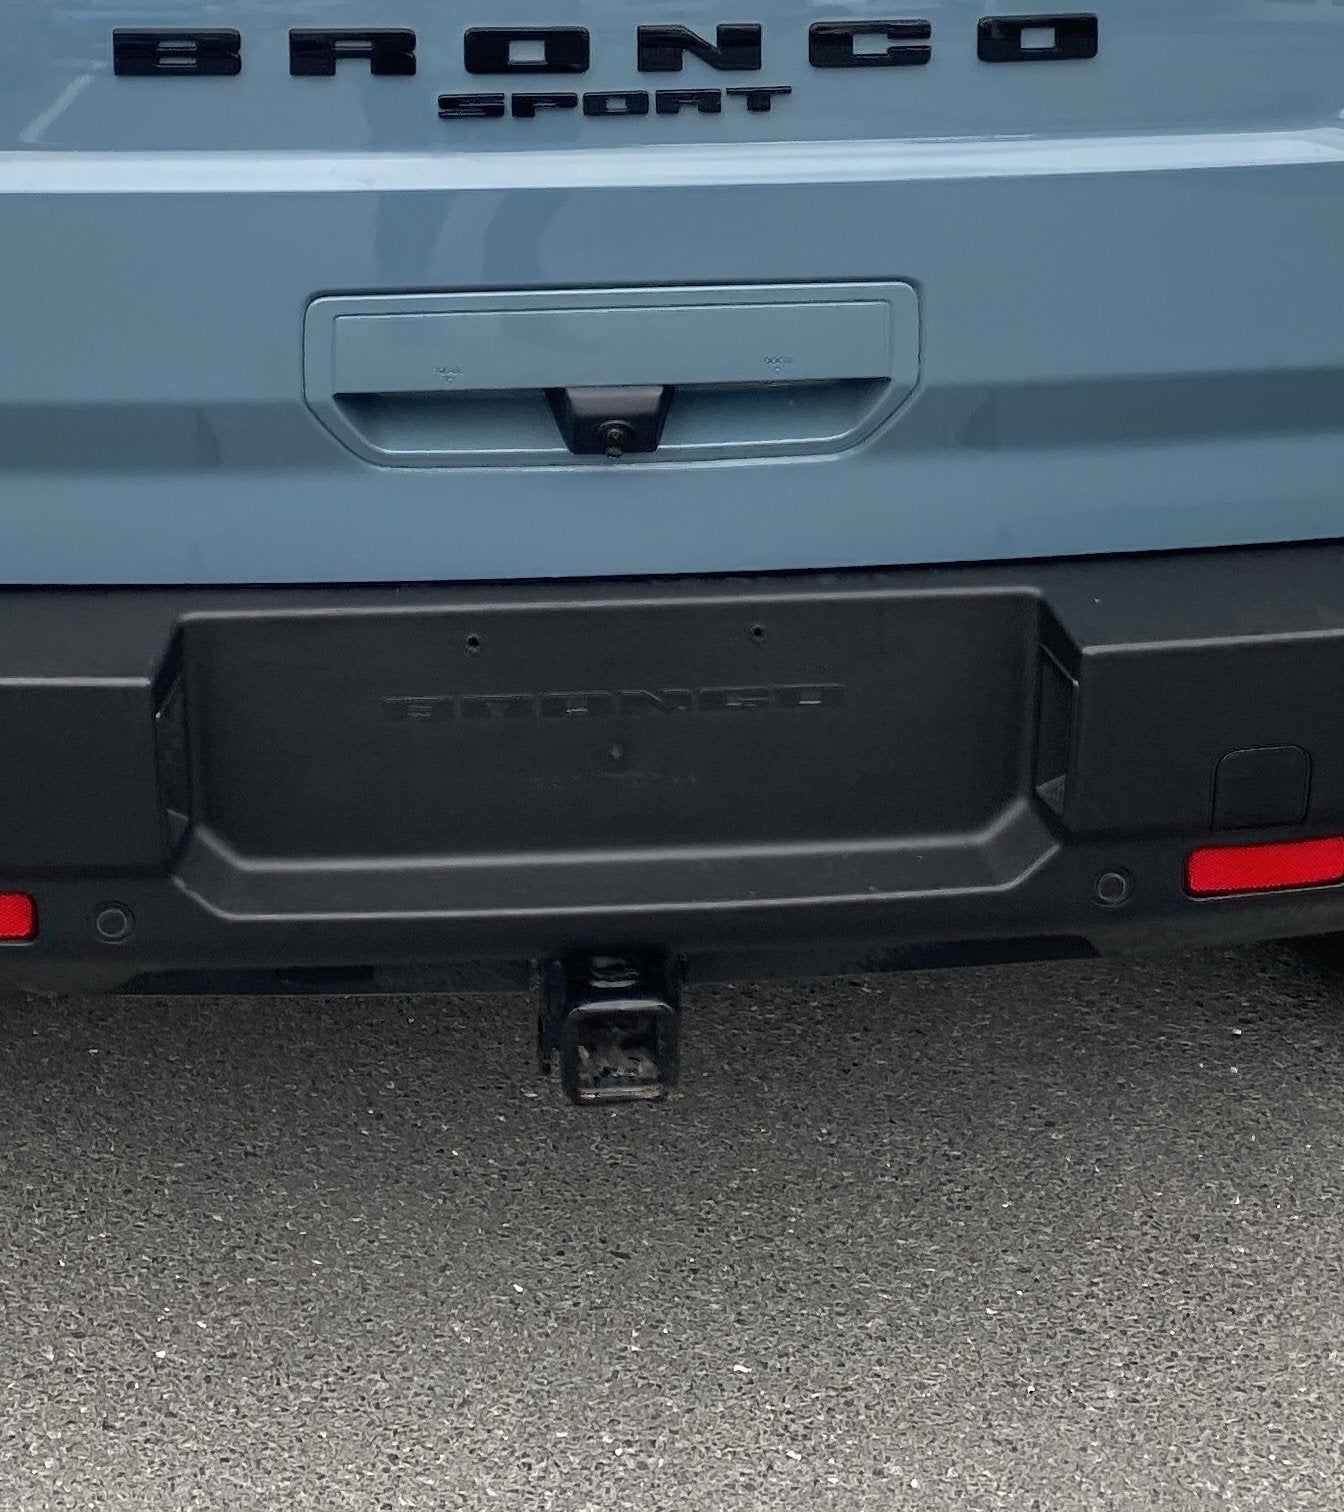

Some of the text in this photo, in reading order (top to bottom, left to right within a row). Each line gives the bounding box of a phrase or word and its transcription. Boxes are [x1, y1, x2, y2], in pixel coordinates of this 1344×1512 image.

[112, 12, 1099, 77] BRONCO
[437, 86, 793, 119] SPORT
[382, 683, 844, 723] BRONCO
